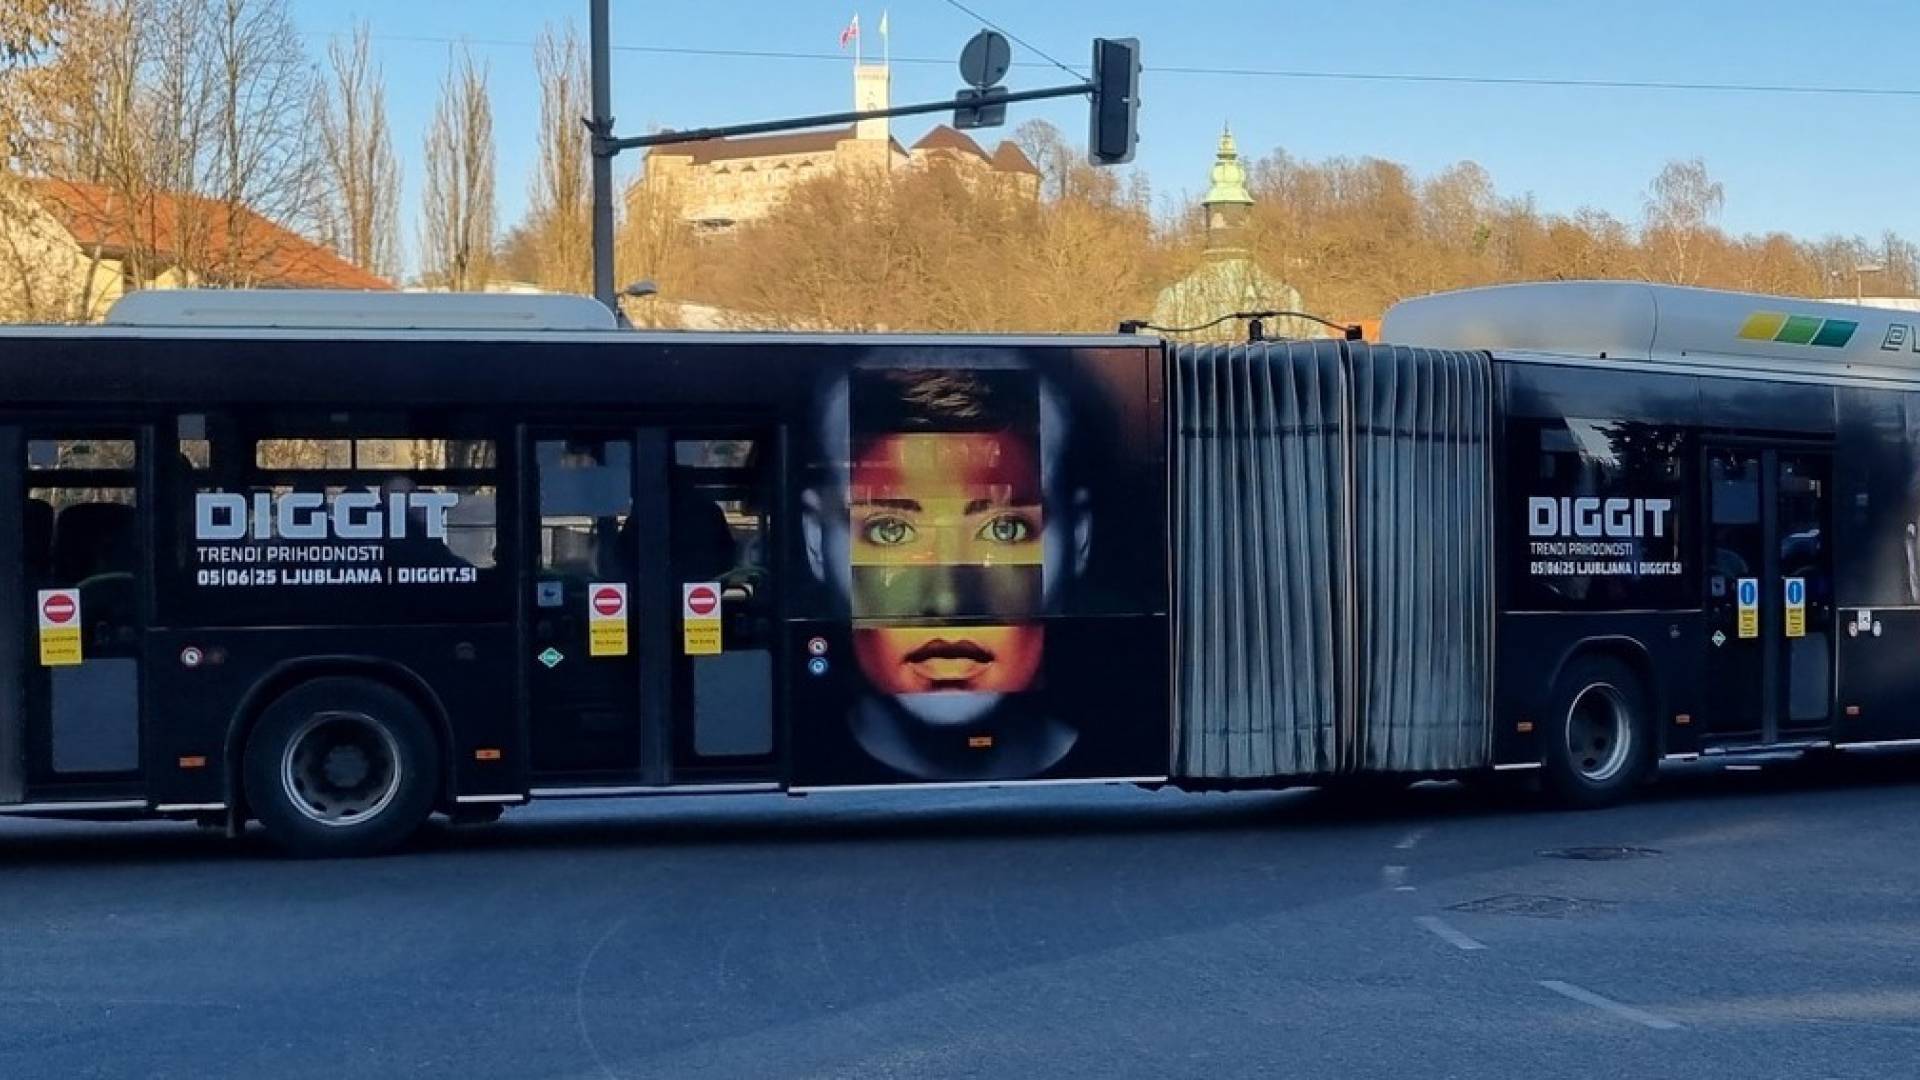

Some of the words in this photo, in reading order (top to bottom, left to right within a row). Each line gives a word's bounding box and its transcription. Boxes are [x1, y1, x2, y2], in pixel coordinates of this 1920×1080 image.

[195, 492, 459, 540] DIGGIT
[1528, 496, 1671, 537] DIGGIT
[197, 545, 262, 563] TRENDI
[267, 545, 384, 563] PRIHODNOSTI
[282, 567, 383, 585] LJUBLJANA
[398, 566, 477, 584] DIGGIT.SI
[1576, 561, 1633, 575] LJUBLJANA
